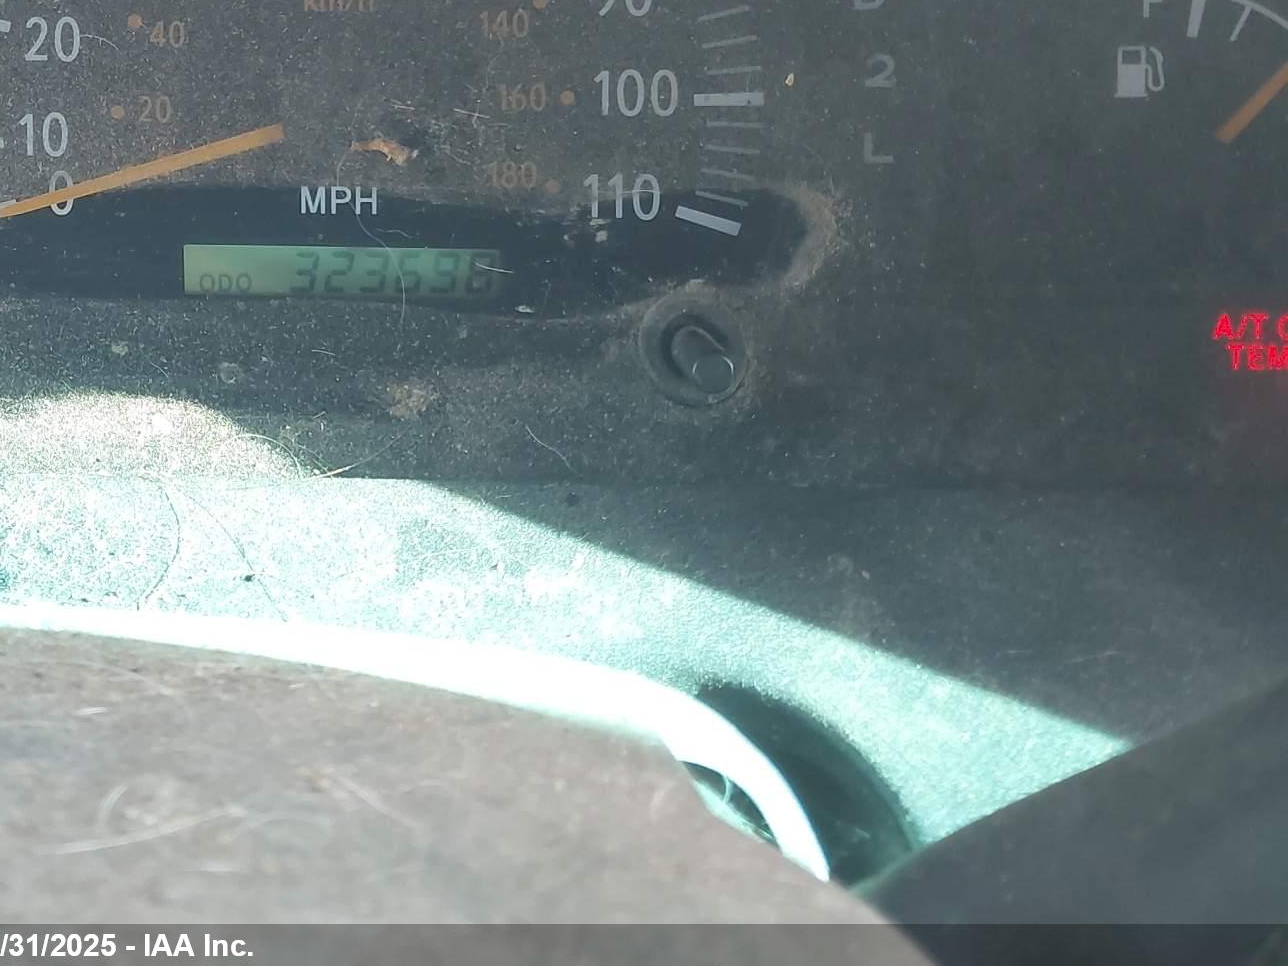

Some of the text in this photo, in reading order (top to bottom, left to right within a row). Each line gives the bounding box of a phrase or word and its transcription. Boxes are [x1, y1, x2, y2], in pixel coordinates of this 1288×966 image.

[24, 15, 81, 63] 20
[149, 20, 186, 48] 40
[479, 10, 529, 38] 140
[865, 54, 897, 89] 2
[500, 84, 547, 112] 160
[593, 68, 679, 118] 100
[137, 95, 172, 123] 20
[16, 111, 69, 158] 10
[864, 133, 895, 164] L
[488, 161, 538, 189] 180
[48, 170, 75, 217] 0
[299, 185, 379, 216] MPH
[582, 172, 662, 222] 110
[198, 272, 254, 294] ODO
[1212, 312, 1269, 341] A/T
